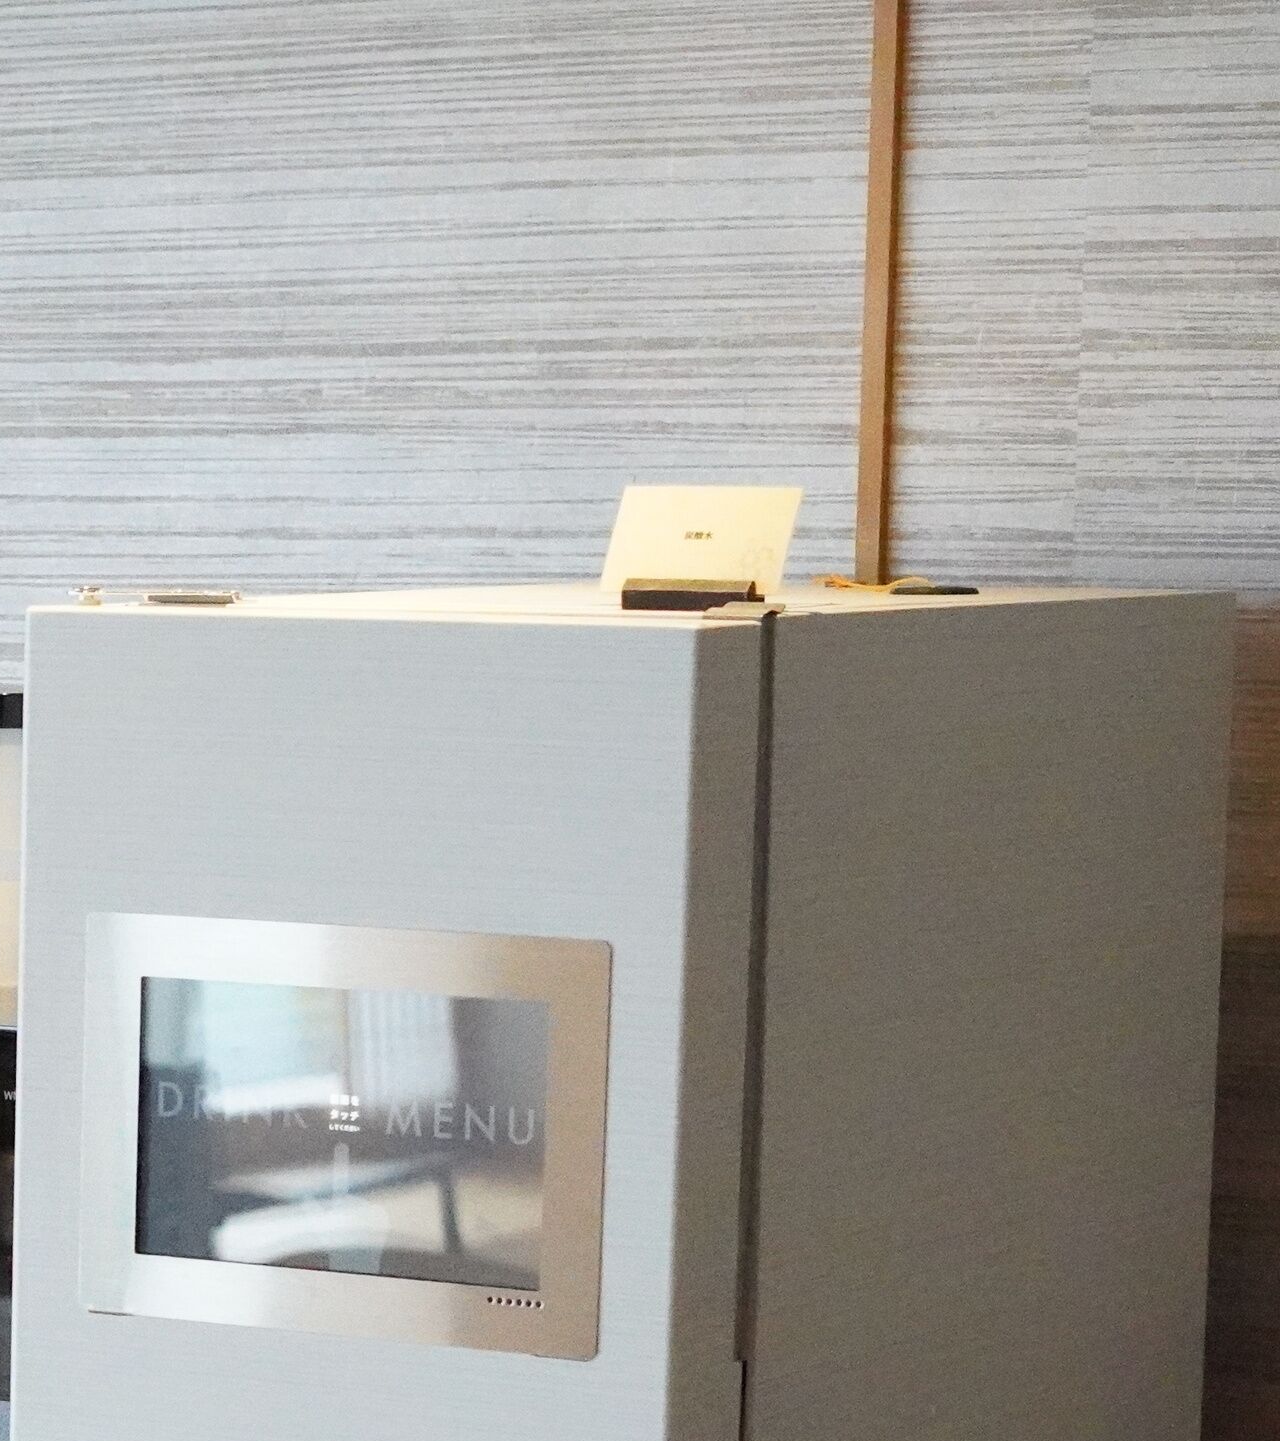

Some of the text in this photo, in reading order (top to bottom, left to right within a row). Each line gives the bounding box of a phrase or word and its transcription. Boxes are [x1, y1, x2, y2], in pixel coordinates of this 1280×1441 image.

[330, 1109, 360, 1121] タッチ
[385, 1102, 536, 1146] MENU
